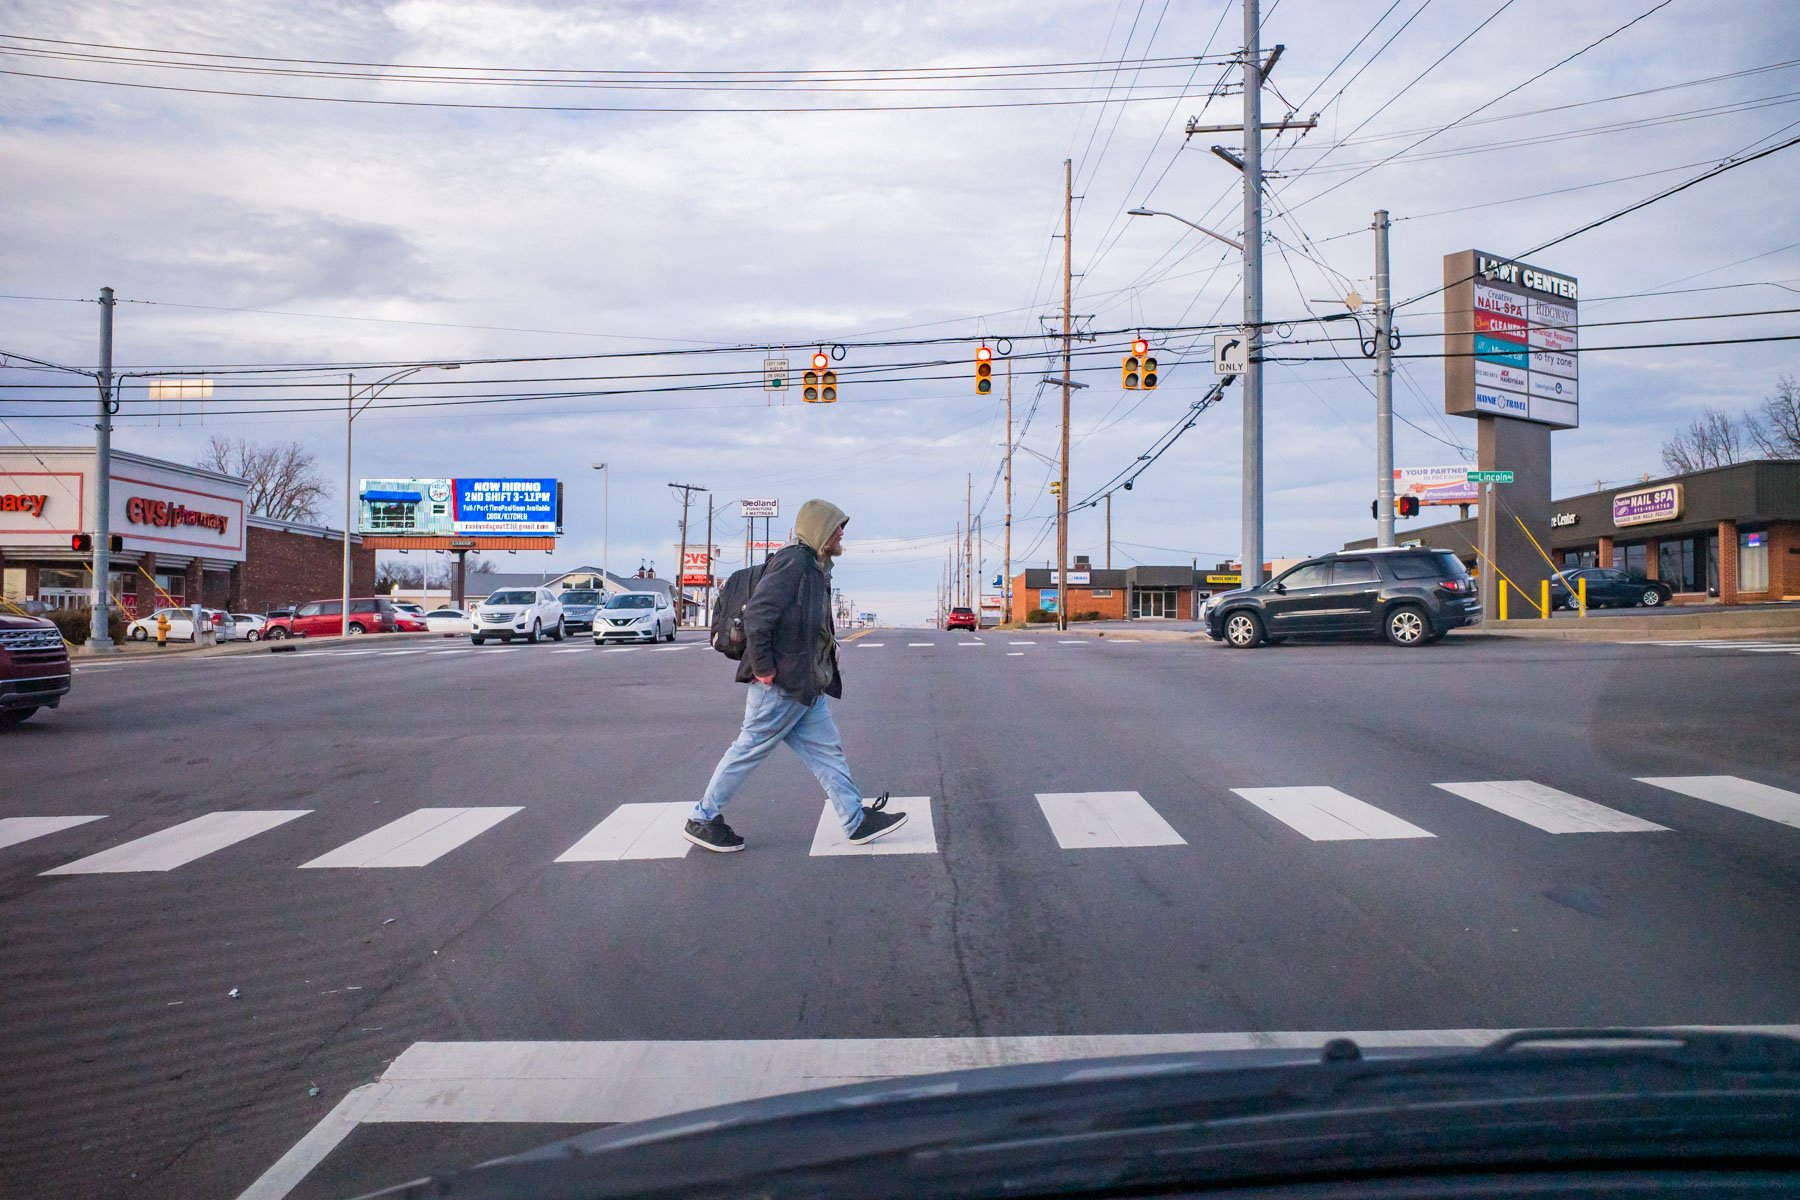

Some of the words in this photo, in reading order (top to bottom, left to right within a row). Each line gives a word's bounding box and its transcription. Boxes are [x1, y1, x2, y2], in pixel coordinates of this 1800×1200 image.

[1522, 269, 1577, 300] CENTER
[1477, 296, 1501, 312] NAIL
[1504, 302, 1522, 317] SPA
[1536, 301, 1569, 322] RIDGWAY
[1219, 363, 1244, 371] ONLY
[1556, 356, 1572, 368] zone
[1506, 399, 1526, 411] TRAVEL
[1405, 468, 1428, 476] YOUR
[1430, 467, 1468, 476] PARTNER
[1479, 472, 1508, 482] Lincoln
[474, 482, 500, 492] NOW
[502, 482, 541, 492] HIRING
[465, 492, 484, 502] 2ND
[484, 492, 512, 502] SHIFT
[513, 492, 551, 502] 3-11PM
[742, 499, 777, 507] Bedland
[1631, 494, 1652, 507] NAIL
[1654, 490, 1674, 503] SPA
[0, 494, 48, 517] acy
[1557, 513, 1576, 527] Center
